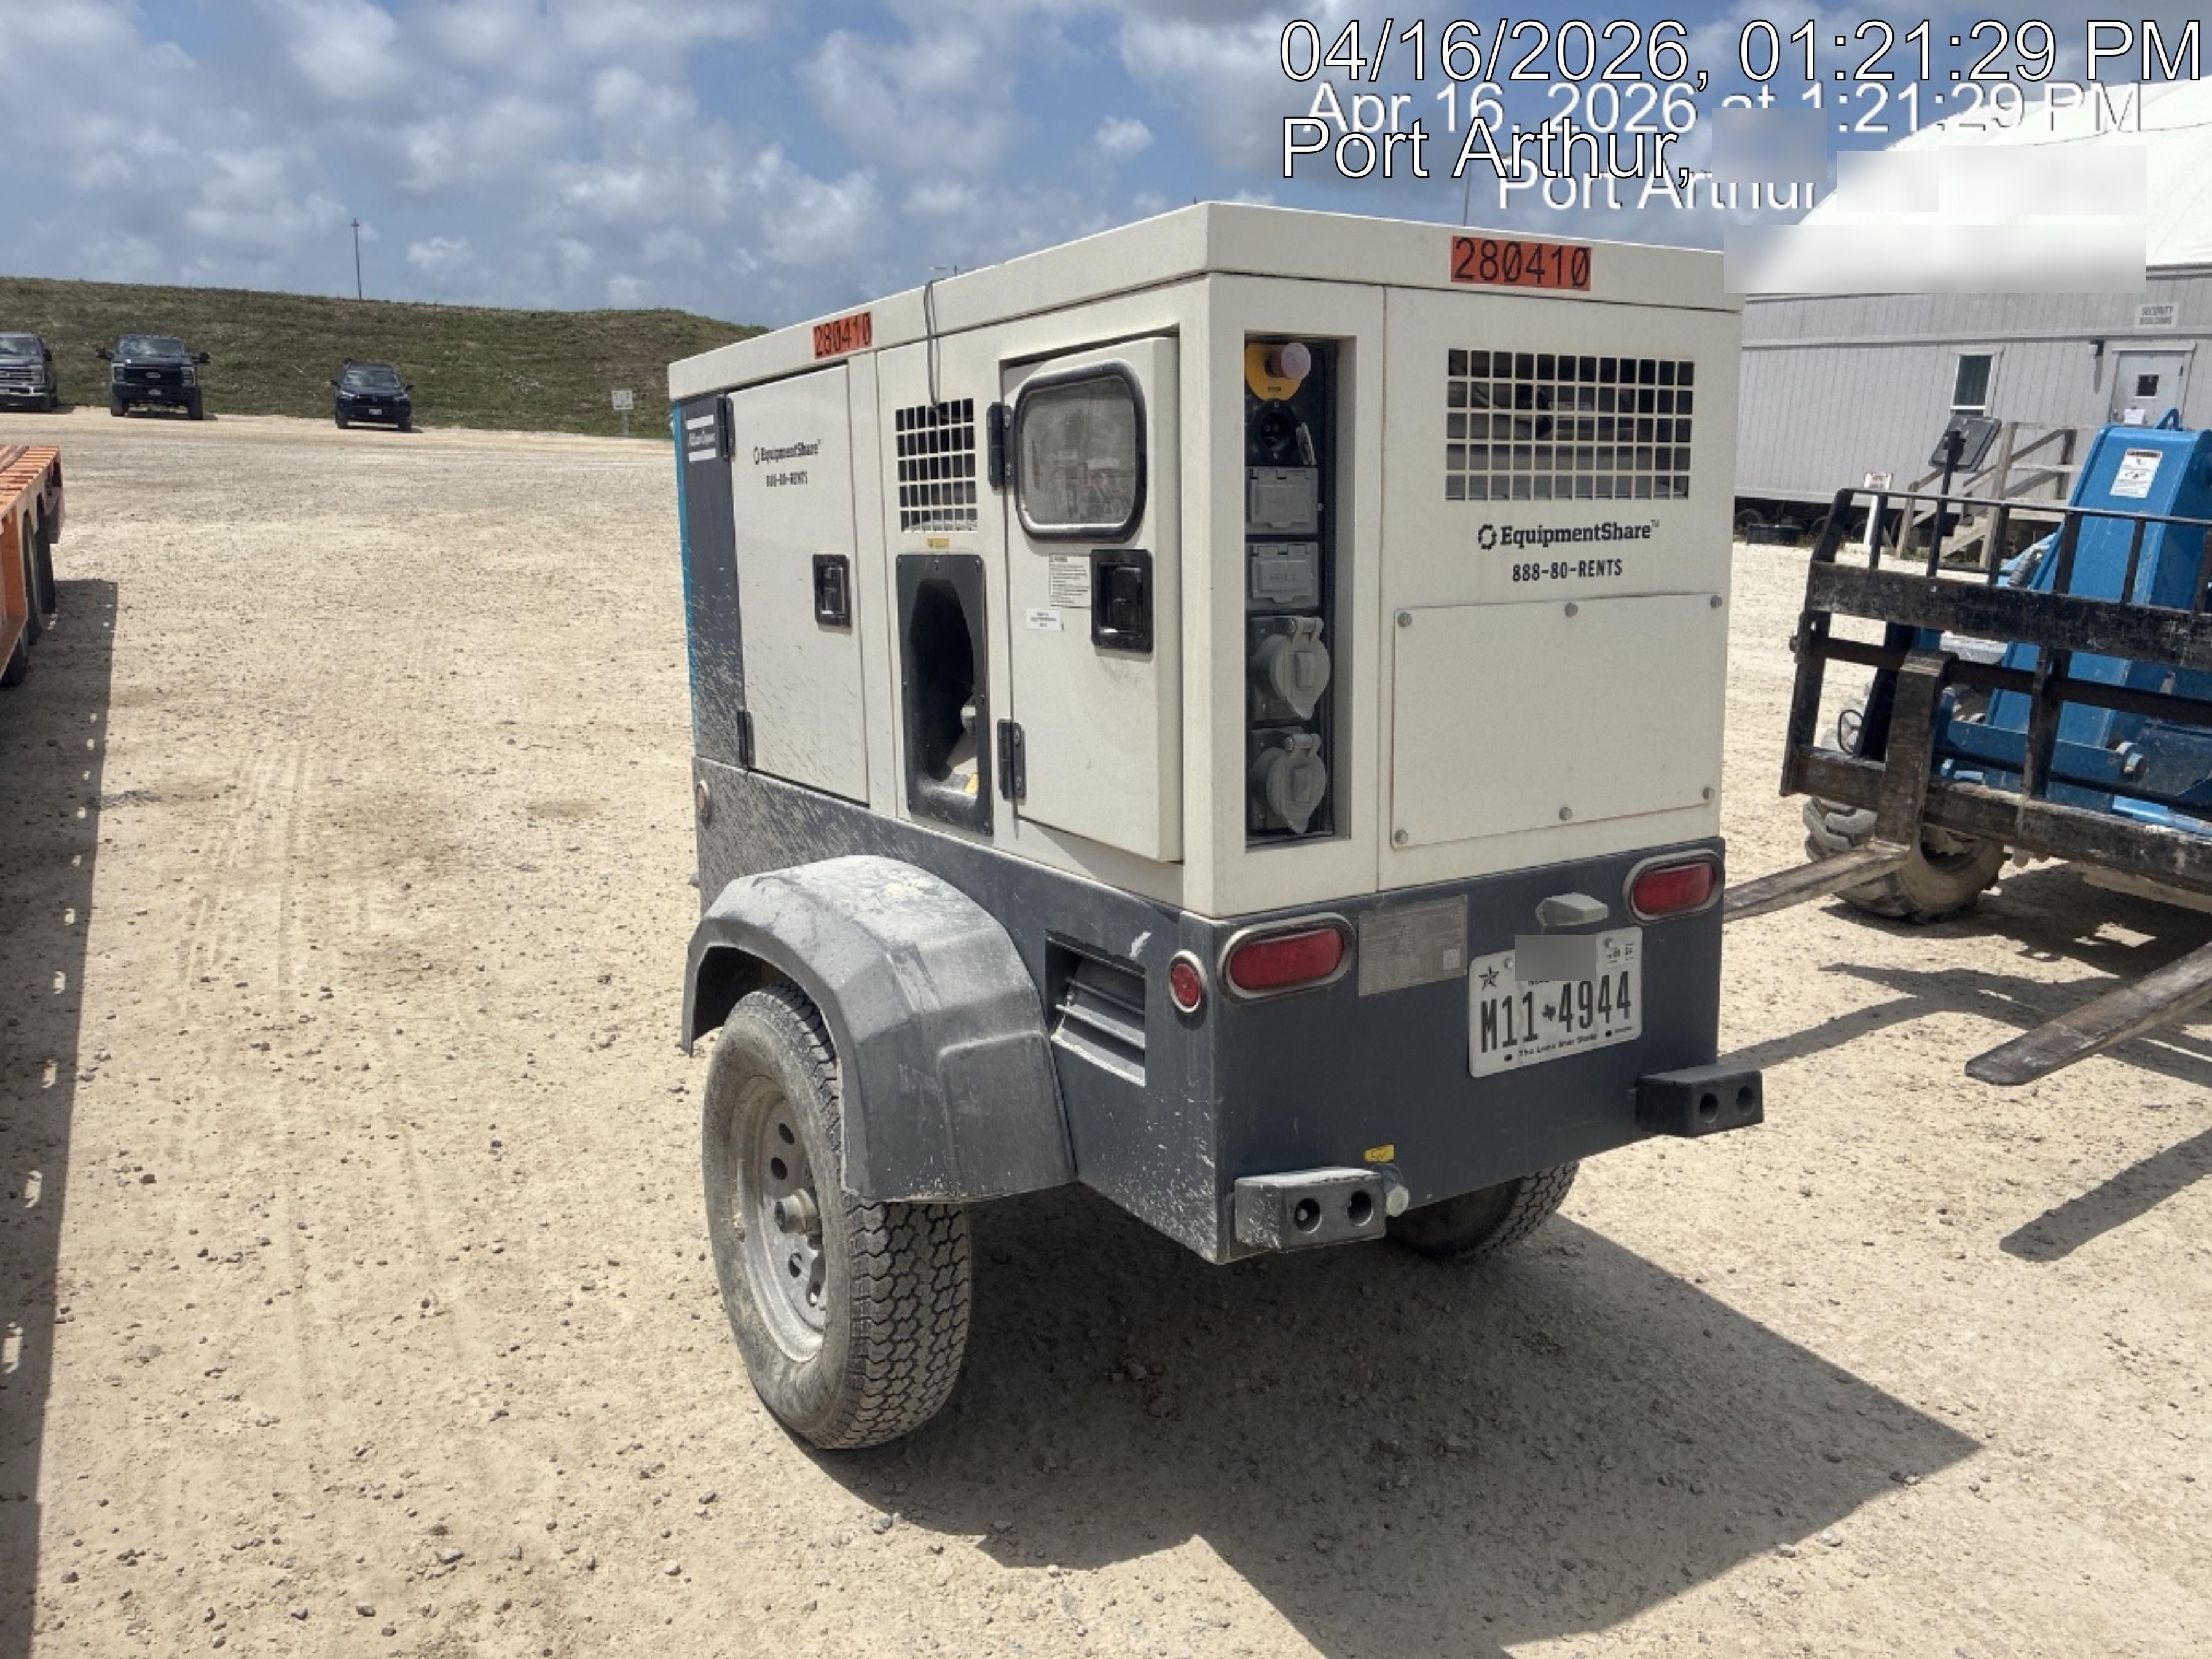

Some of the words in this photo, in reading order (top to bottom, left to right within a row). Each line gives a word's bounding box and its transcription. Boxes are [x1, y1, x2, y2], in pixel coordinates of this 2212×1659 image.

[1454, 237, 1590, 288] 280410
[814, 311, 872, 357] 280410
[1512, 558, 1623, 583] 888-80-RENTS
